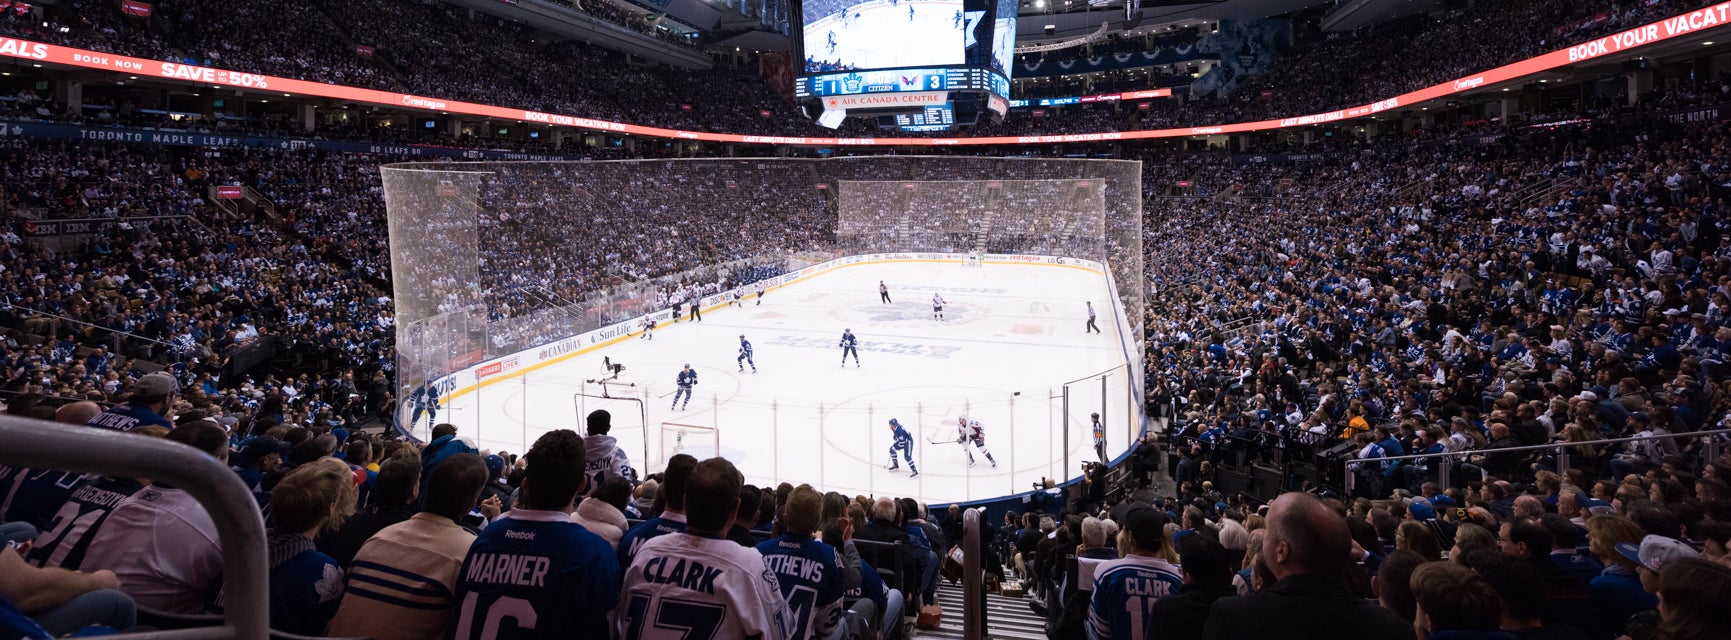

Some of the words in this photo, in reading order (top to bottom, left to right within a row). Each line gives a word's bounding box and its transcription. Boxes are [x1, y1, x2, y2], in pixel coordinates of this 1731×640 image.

[1569, 39, 1608, 62] BOOK
[1612, 25, 1658, 50] YOUR
[1664, 3, 1731, 36] VACAT
[0, 38, 48, 59] ALS
[73, 53, 108, 65] BOOK
[115, 60, 143, 70] NOW
[161, 62, 215, 82] SAVE
[229, 71, 268, 89] 50%
[831, 81, 836, 93] 1
[930, 75, 940, 89] 3
[526, 111, 549, 122] BOOK
[552, 114, 573, 125] YOUR
[575, 118, 609, 130] VACATION
[611, 122, 626, 132] NOW
[1281, 118, 1297, 127] LAST
[1298, 114, 1324, 125] MINUTE
[1324, 110, 1344, 121] DEALS
[1668, 113, 1685, 124] THE
[1687, 108, 1719, 122] NORTH
[81, 129, 142, 142] TORONTO
[153, 134, 194, 144] MAPLE
[203, 137, 239, 146] LEAFS
[35, 223, 57, 235] IBM
[66, 222, 90, 234] IBM
[599, 329, 615, 341] Sun
[616, 323, 631, 336] Life
[548, 339, 582, 358] CANADIAN
[505, 530, 536, 541] Reebok
[779, 540, 801, 549] Reebok
[466, 553, 550, 587] MARNER
[643, 557, 723, 595] CLARK
[1137, 570, 1158, 579] Reebok
[1125, 577, 1171, 597] CLARK
